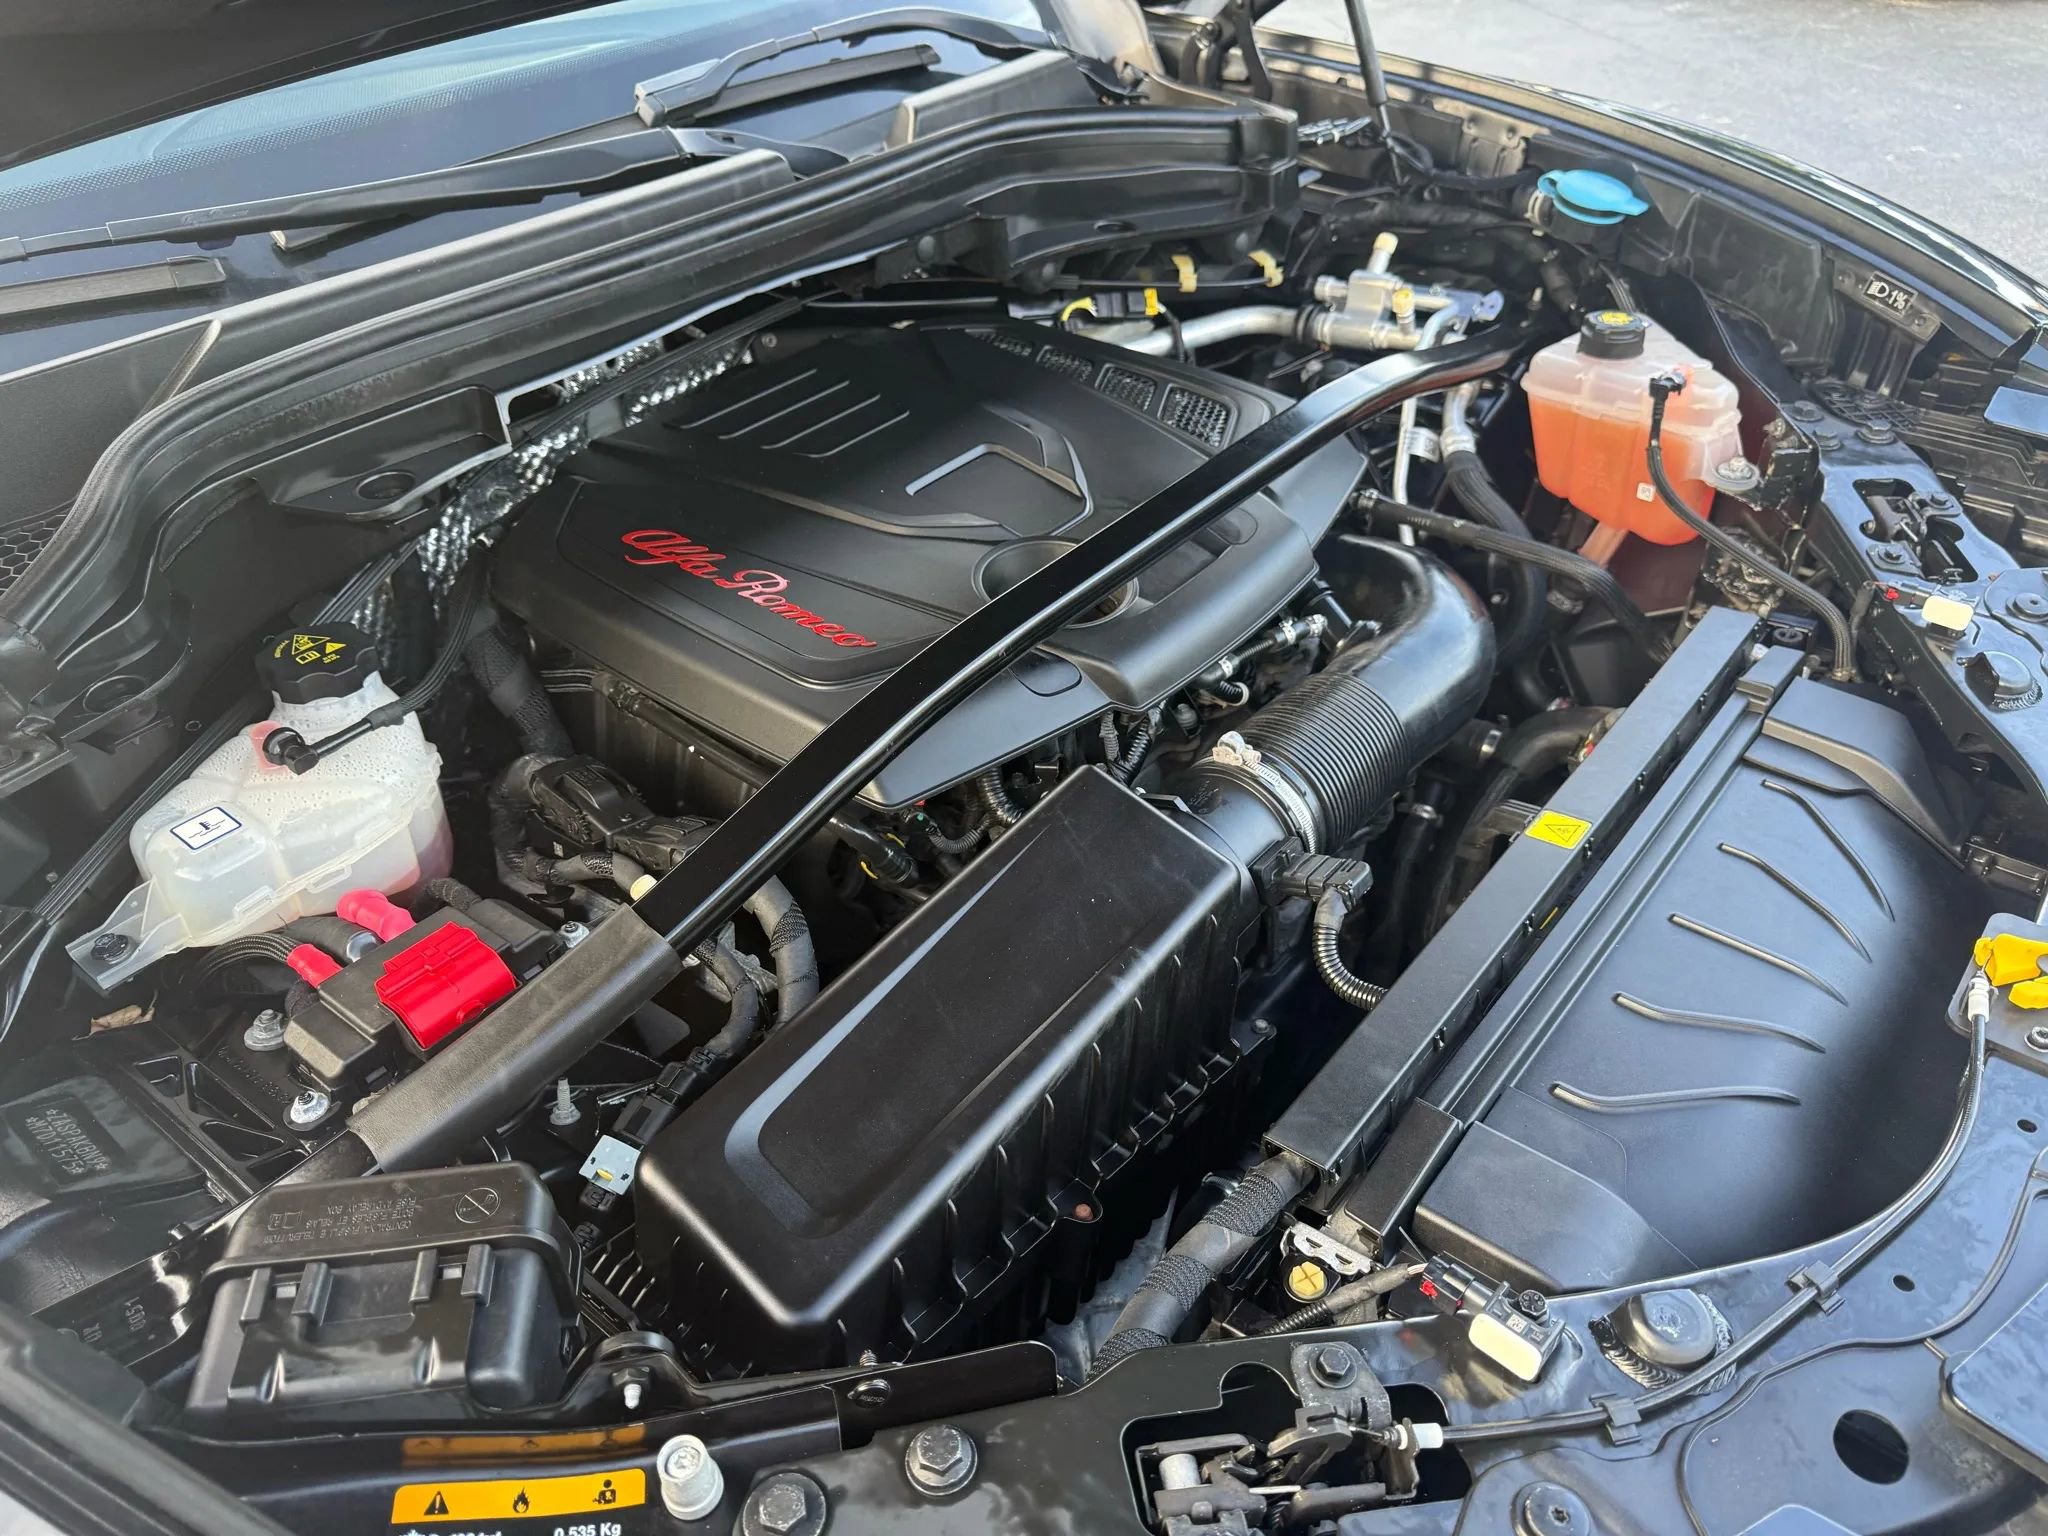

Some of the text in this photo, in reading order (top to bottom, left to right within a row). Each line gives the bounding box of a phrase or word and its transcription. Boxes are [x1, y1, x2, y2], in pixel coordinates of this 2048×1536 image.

[621, 529, 878, 647] Alfa Romeo
[553, 1522, 622, 1536] 0535 Kg
